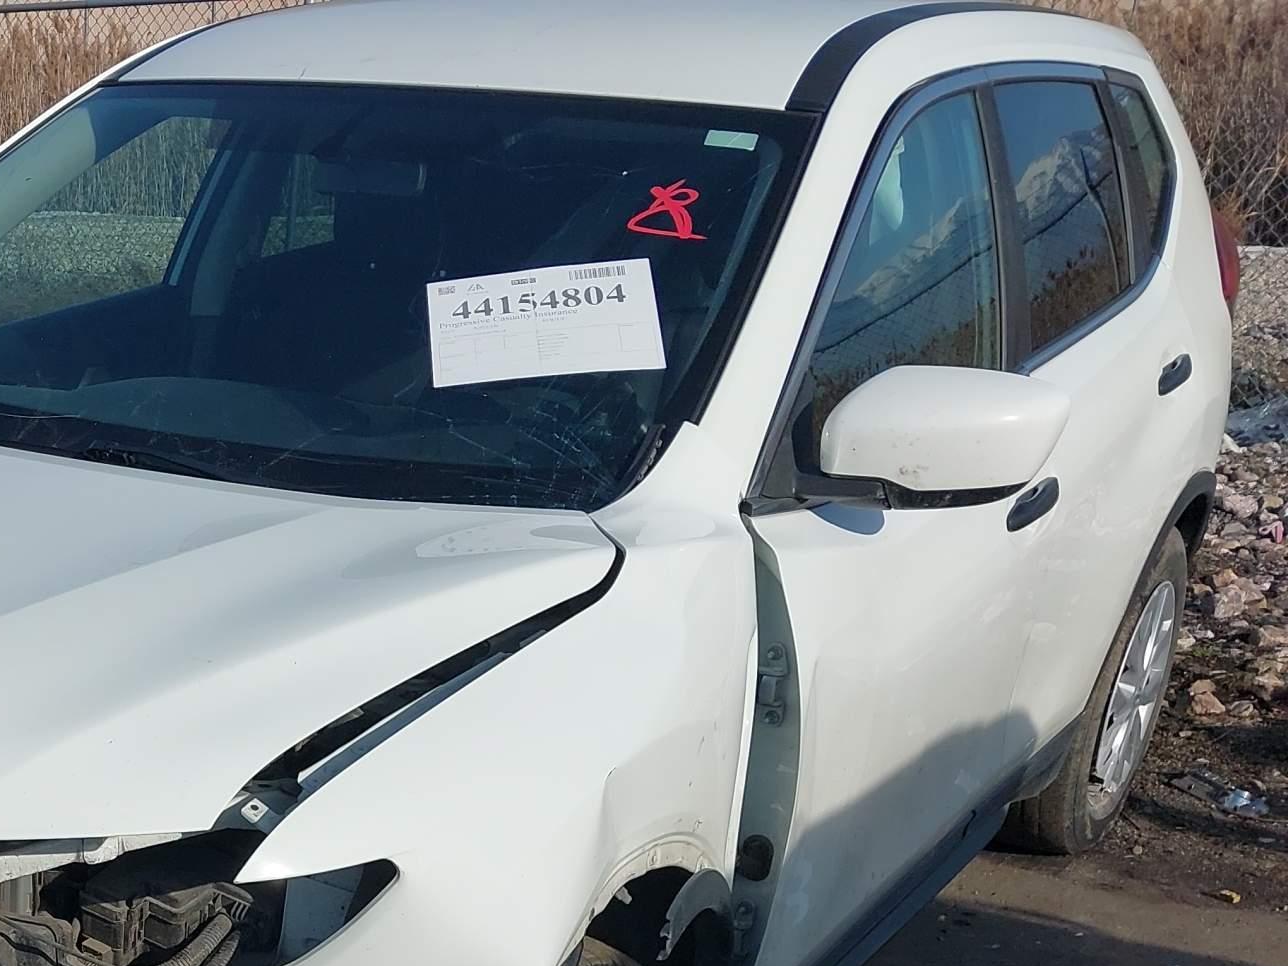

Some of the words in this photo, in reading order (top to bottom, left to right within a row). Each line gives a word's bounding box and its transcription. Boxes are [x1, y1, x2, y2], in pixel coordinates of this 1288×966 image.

[452, 283, 626, 319] 44154804
[439, 318, 490, 329] Progressive
[493, 312, 530, 322] Casualty
[535, 309, 578, 318] Insurance
